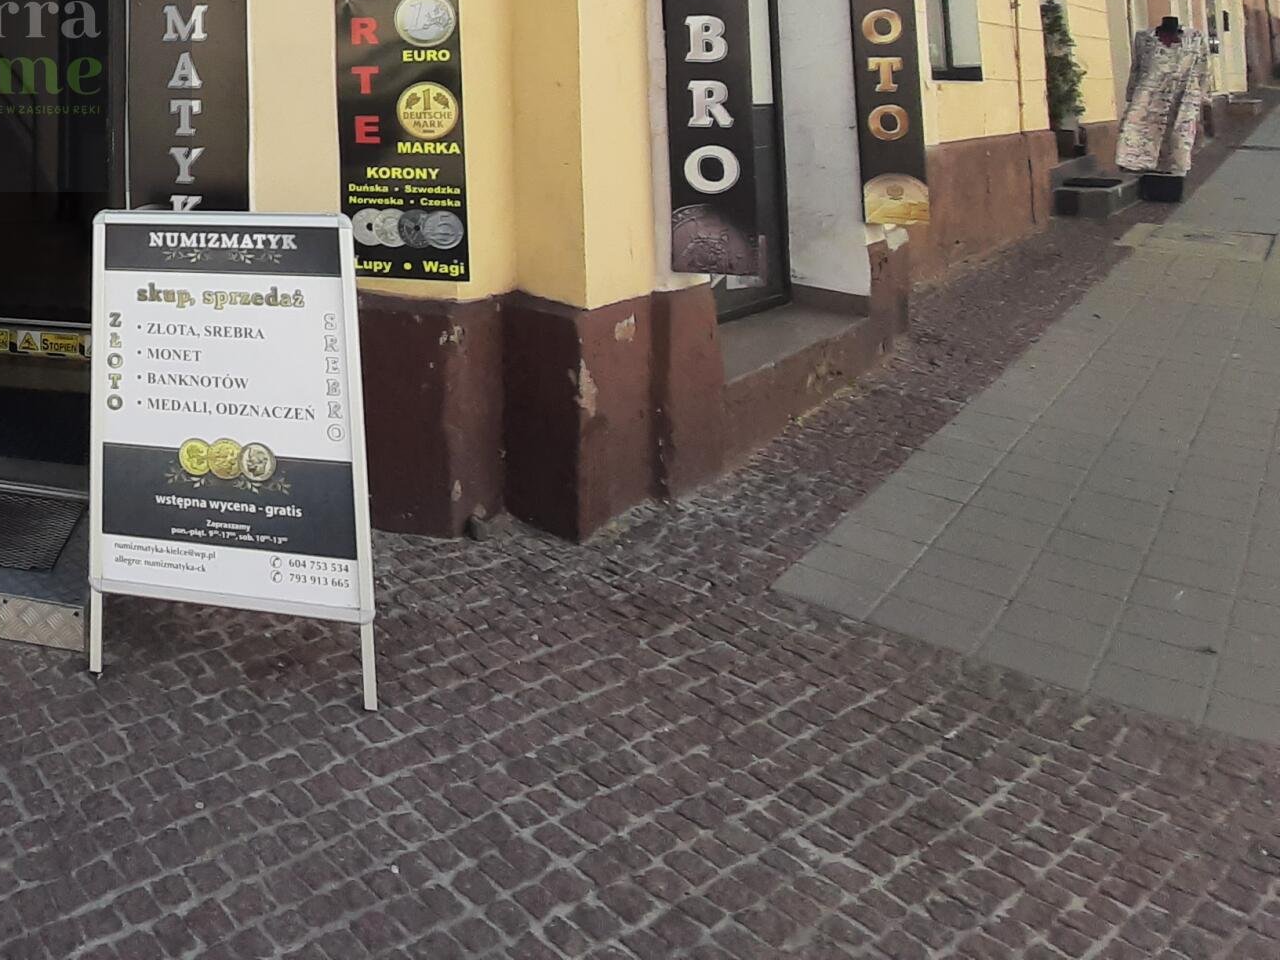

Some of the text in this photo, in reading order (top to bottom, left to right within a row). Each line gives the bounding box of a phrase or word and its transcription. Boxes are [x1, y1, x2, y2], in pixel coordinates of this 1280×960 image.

[402, 49, 451, 62] EURO
[403, 111, 453, 120] DEUTSCHE
[413, 120, 444, 129] MARK
[397, 142, 461, 155] MARKA
[366, 167, 440, 180] KORONY
[349, 183, 461, 194] Duńska Szwedzka
[349, 196, 461, 207] Norweska Czeska
[149, 231, 298, 250] NUMIZMATYK
[423, 260, 465, 277] Wagi
[137, 283, 305, 309] skup, sprzedaż
[147, 323, 265, 340] ZŁOTA, SREBRA
[107, 312, 123, 411] ZŁOTO
[147, 348, 202, 362] MONET
[147, 373, 249, 390] BANKNOTÓW
[323, 313, 345, 441] SREBRO
[147, 398, 316, 421] MEDALI, ODZNACZEŃ
[155, 493, 207, 509] wstępna
[210, 499, 257, 514] wycena
[265, 504, 303, 518] gratis
[206, 519, 251, 532] Zapraszamy
[288, 559, 350, 573] 604 753 534
[289, 573, 350, 589] 793 913 665
